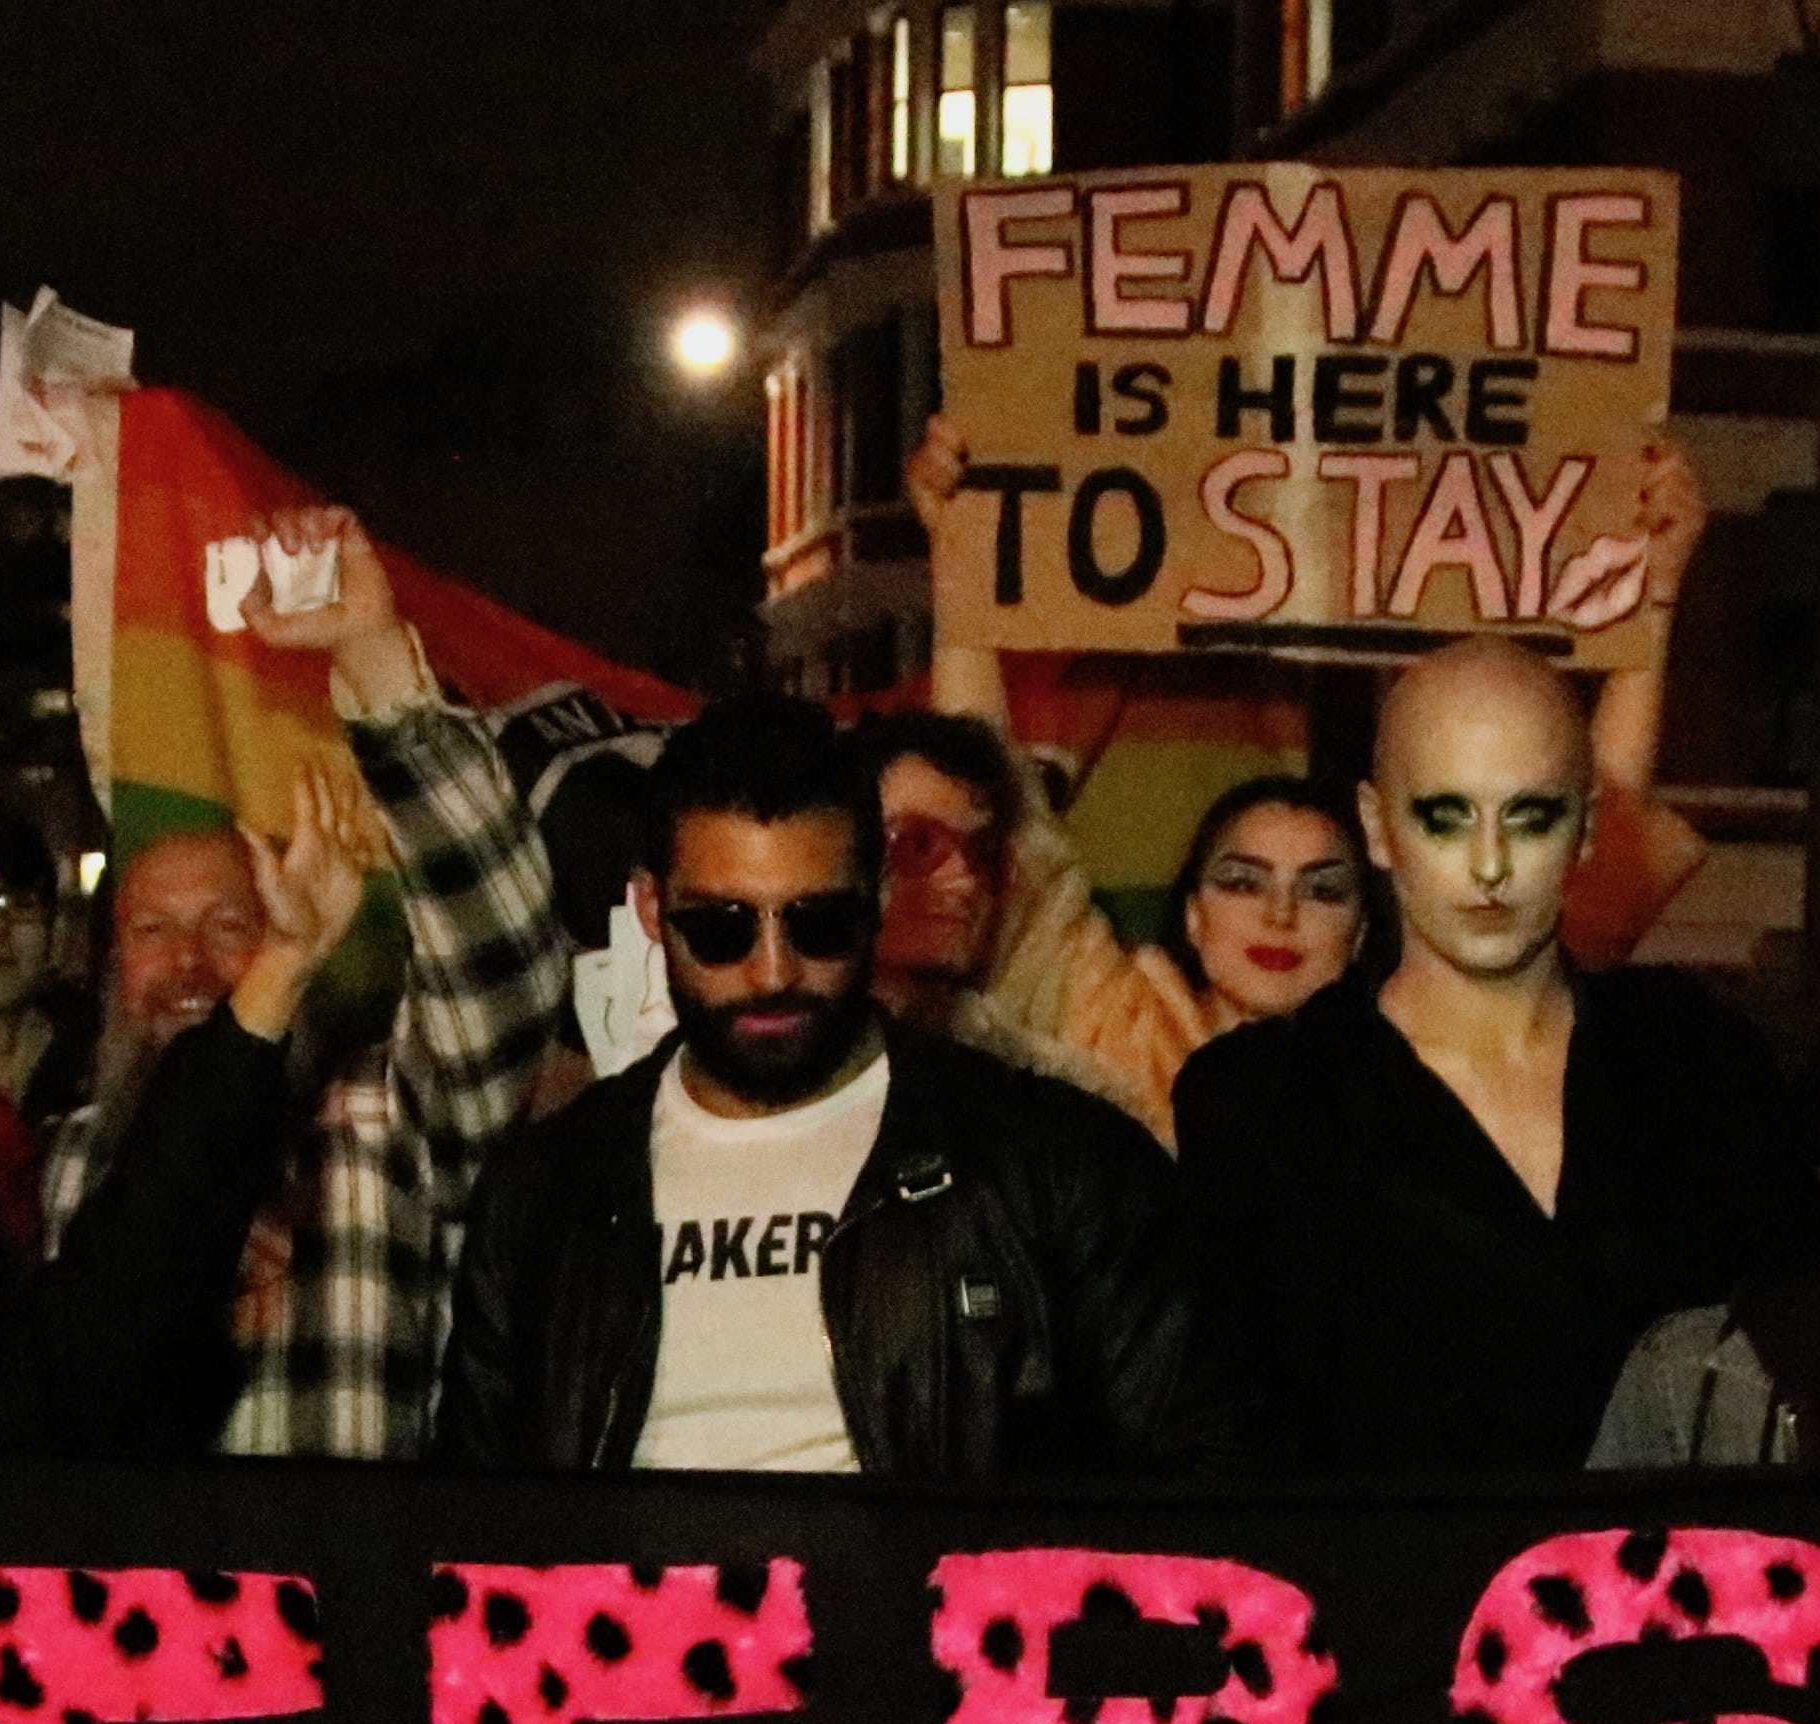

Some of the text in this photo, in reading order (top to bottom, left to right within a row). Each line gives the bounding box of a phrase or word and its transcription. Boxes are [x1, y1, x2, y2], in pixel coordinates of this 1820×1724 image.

[962, 181, 1651, 361] FEMME
[1073, 353, 1539, 446] IS HERE
[958, 449, 1596, 622] TO STAY
[654, 1210, 836, 1286] AKER
